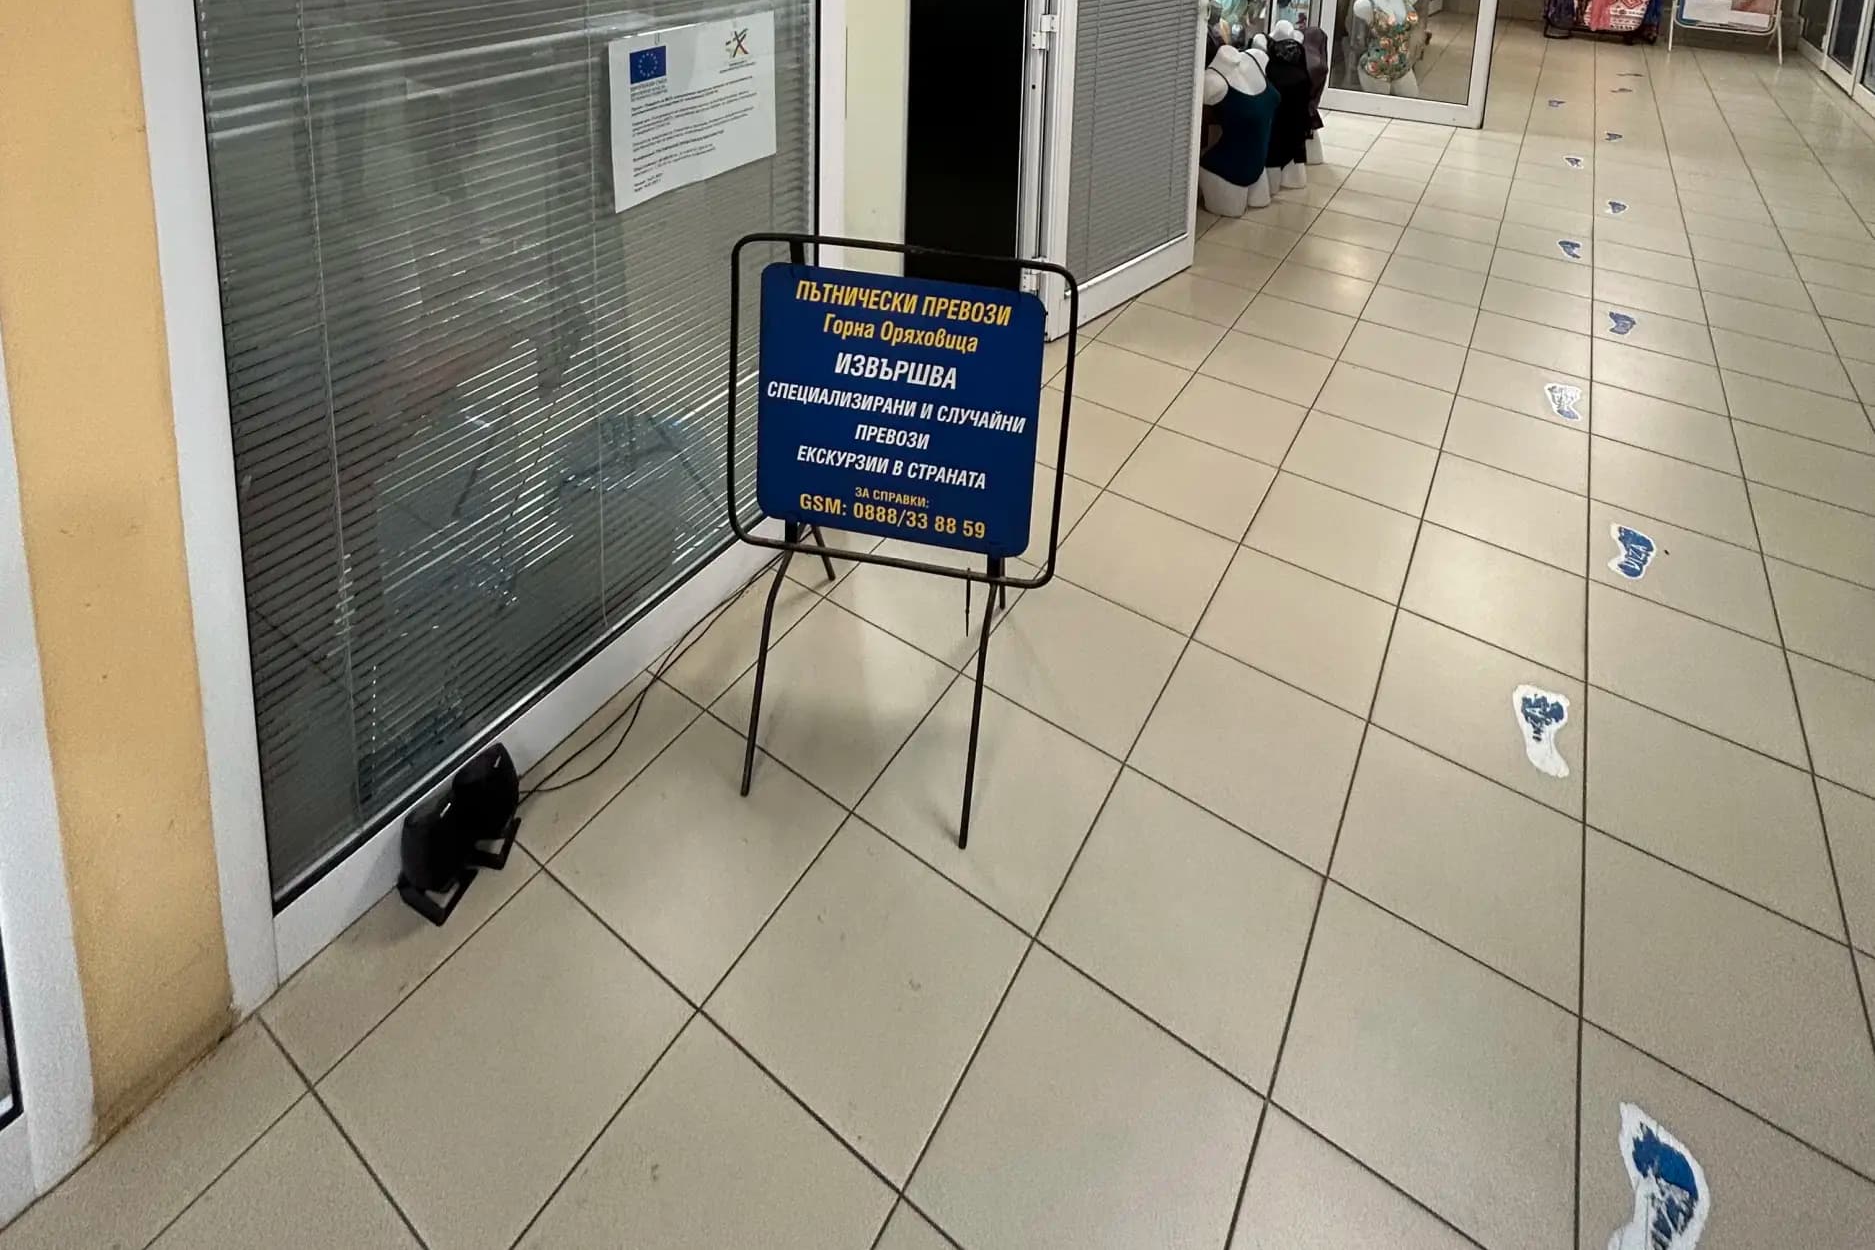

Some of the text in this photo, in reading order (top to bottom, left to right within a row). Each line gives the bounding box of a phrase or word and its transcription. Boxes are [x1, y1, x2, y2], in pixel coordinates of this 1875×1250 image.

[795, 280, 1012, 327] ПЪТНИЧЕСКИ ПРЕВОЗИ
[823, 313, 979, 353] Горна Оряховица
[834, 352, 958, 390] ИЗВЪРШВА
[767, 380, 1027, 434] СПЕЦИАЛИЗИРАНИ И СЛУЧАЙНИ
[854, 424, 930, 450] ПРЕВОЗИ
[796, 445, 986, 490] ЕКСКУРЗИИ В СТРАНАТА
[799, 493, 986, 539] GSM: 0888/33 88 59
[855, 486, 930, 509] ЗА СПРАВКИ:
